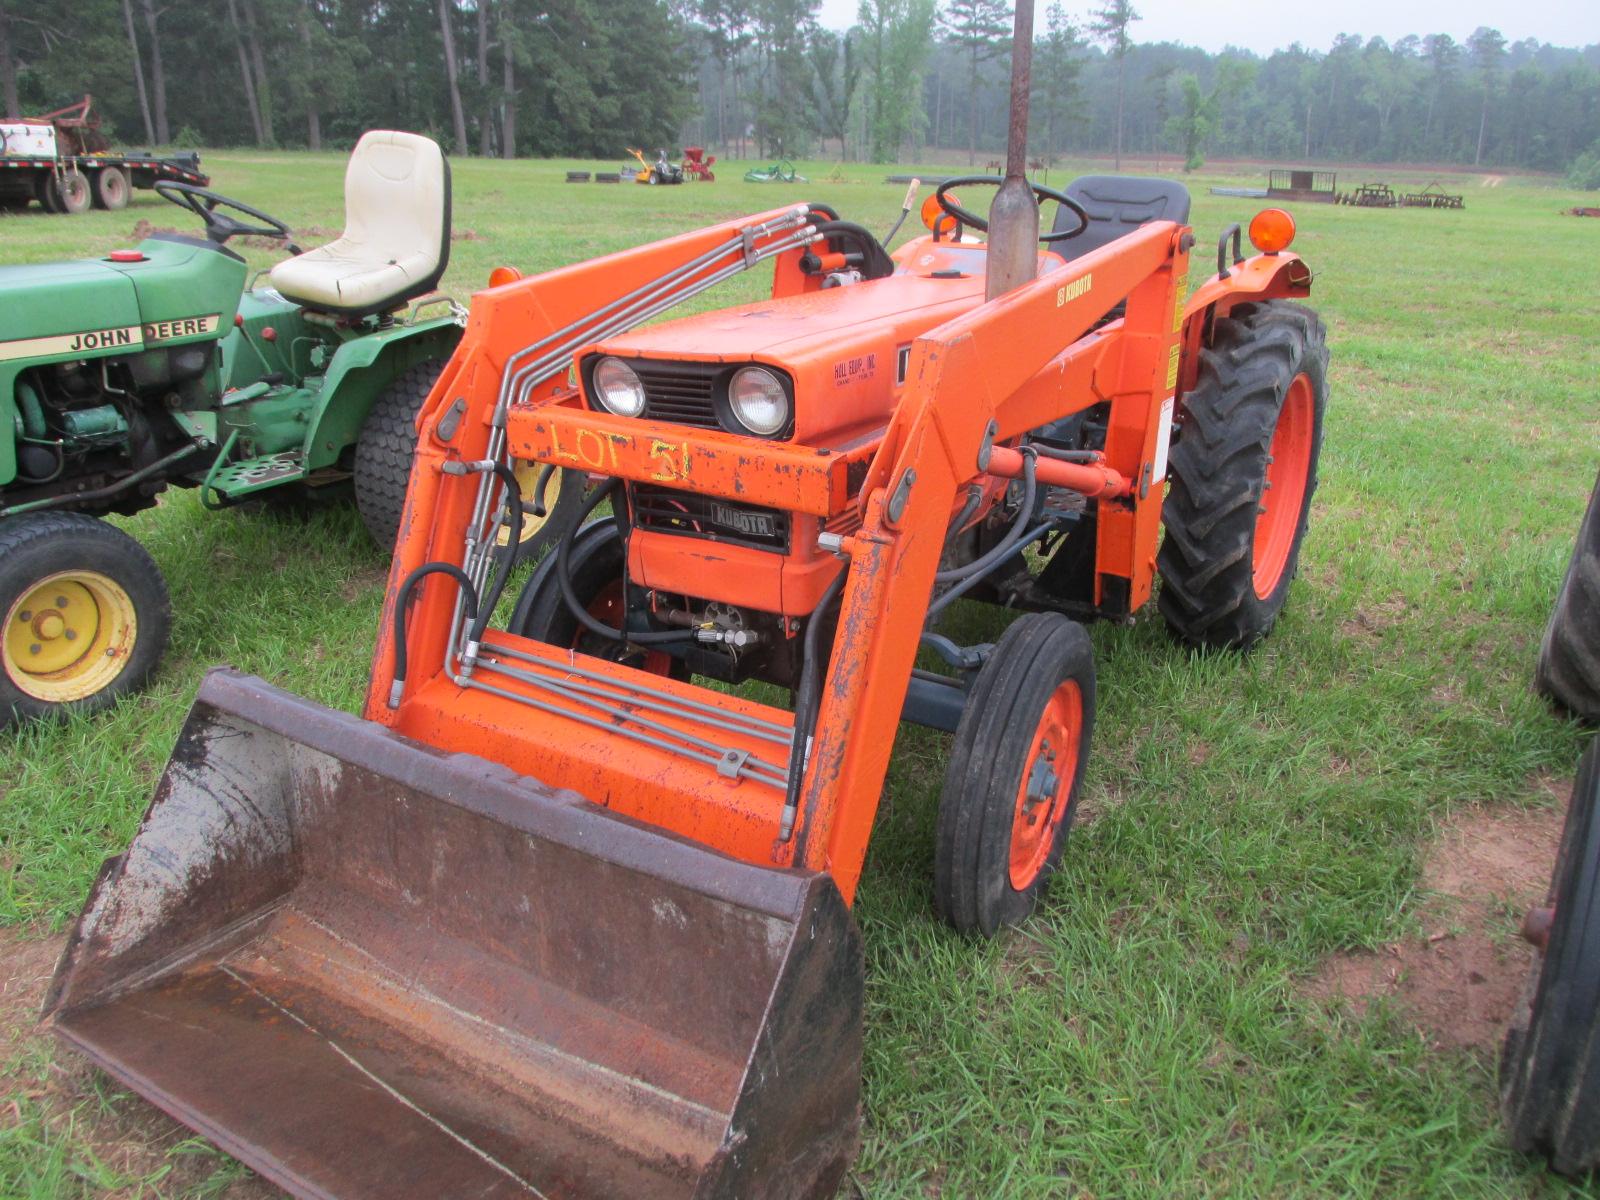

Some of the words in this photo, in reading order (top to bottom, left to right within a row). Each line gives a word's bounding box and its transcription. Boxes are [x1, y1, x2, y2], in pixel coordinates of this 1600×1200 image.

[1065, 272, 1092, 303] KUBOTA
[70, 328, 131, 351] JOHN
[144, 318, 208, 339] DEERE
[550, 424, 635, 469] LOT
[650, 440, 691, 482] 51
[716, 505, 769, 534] KUBOTA
